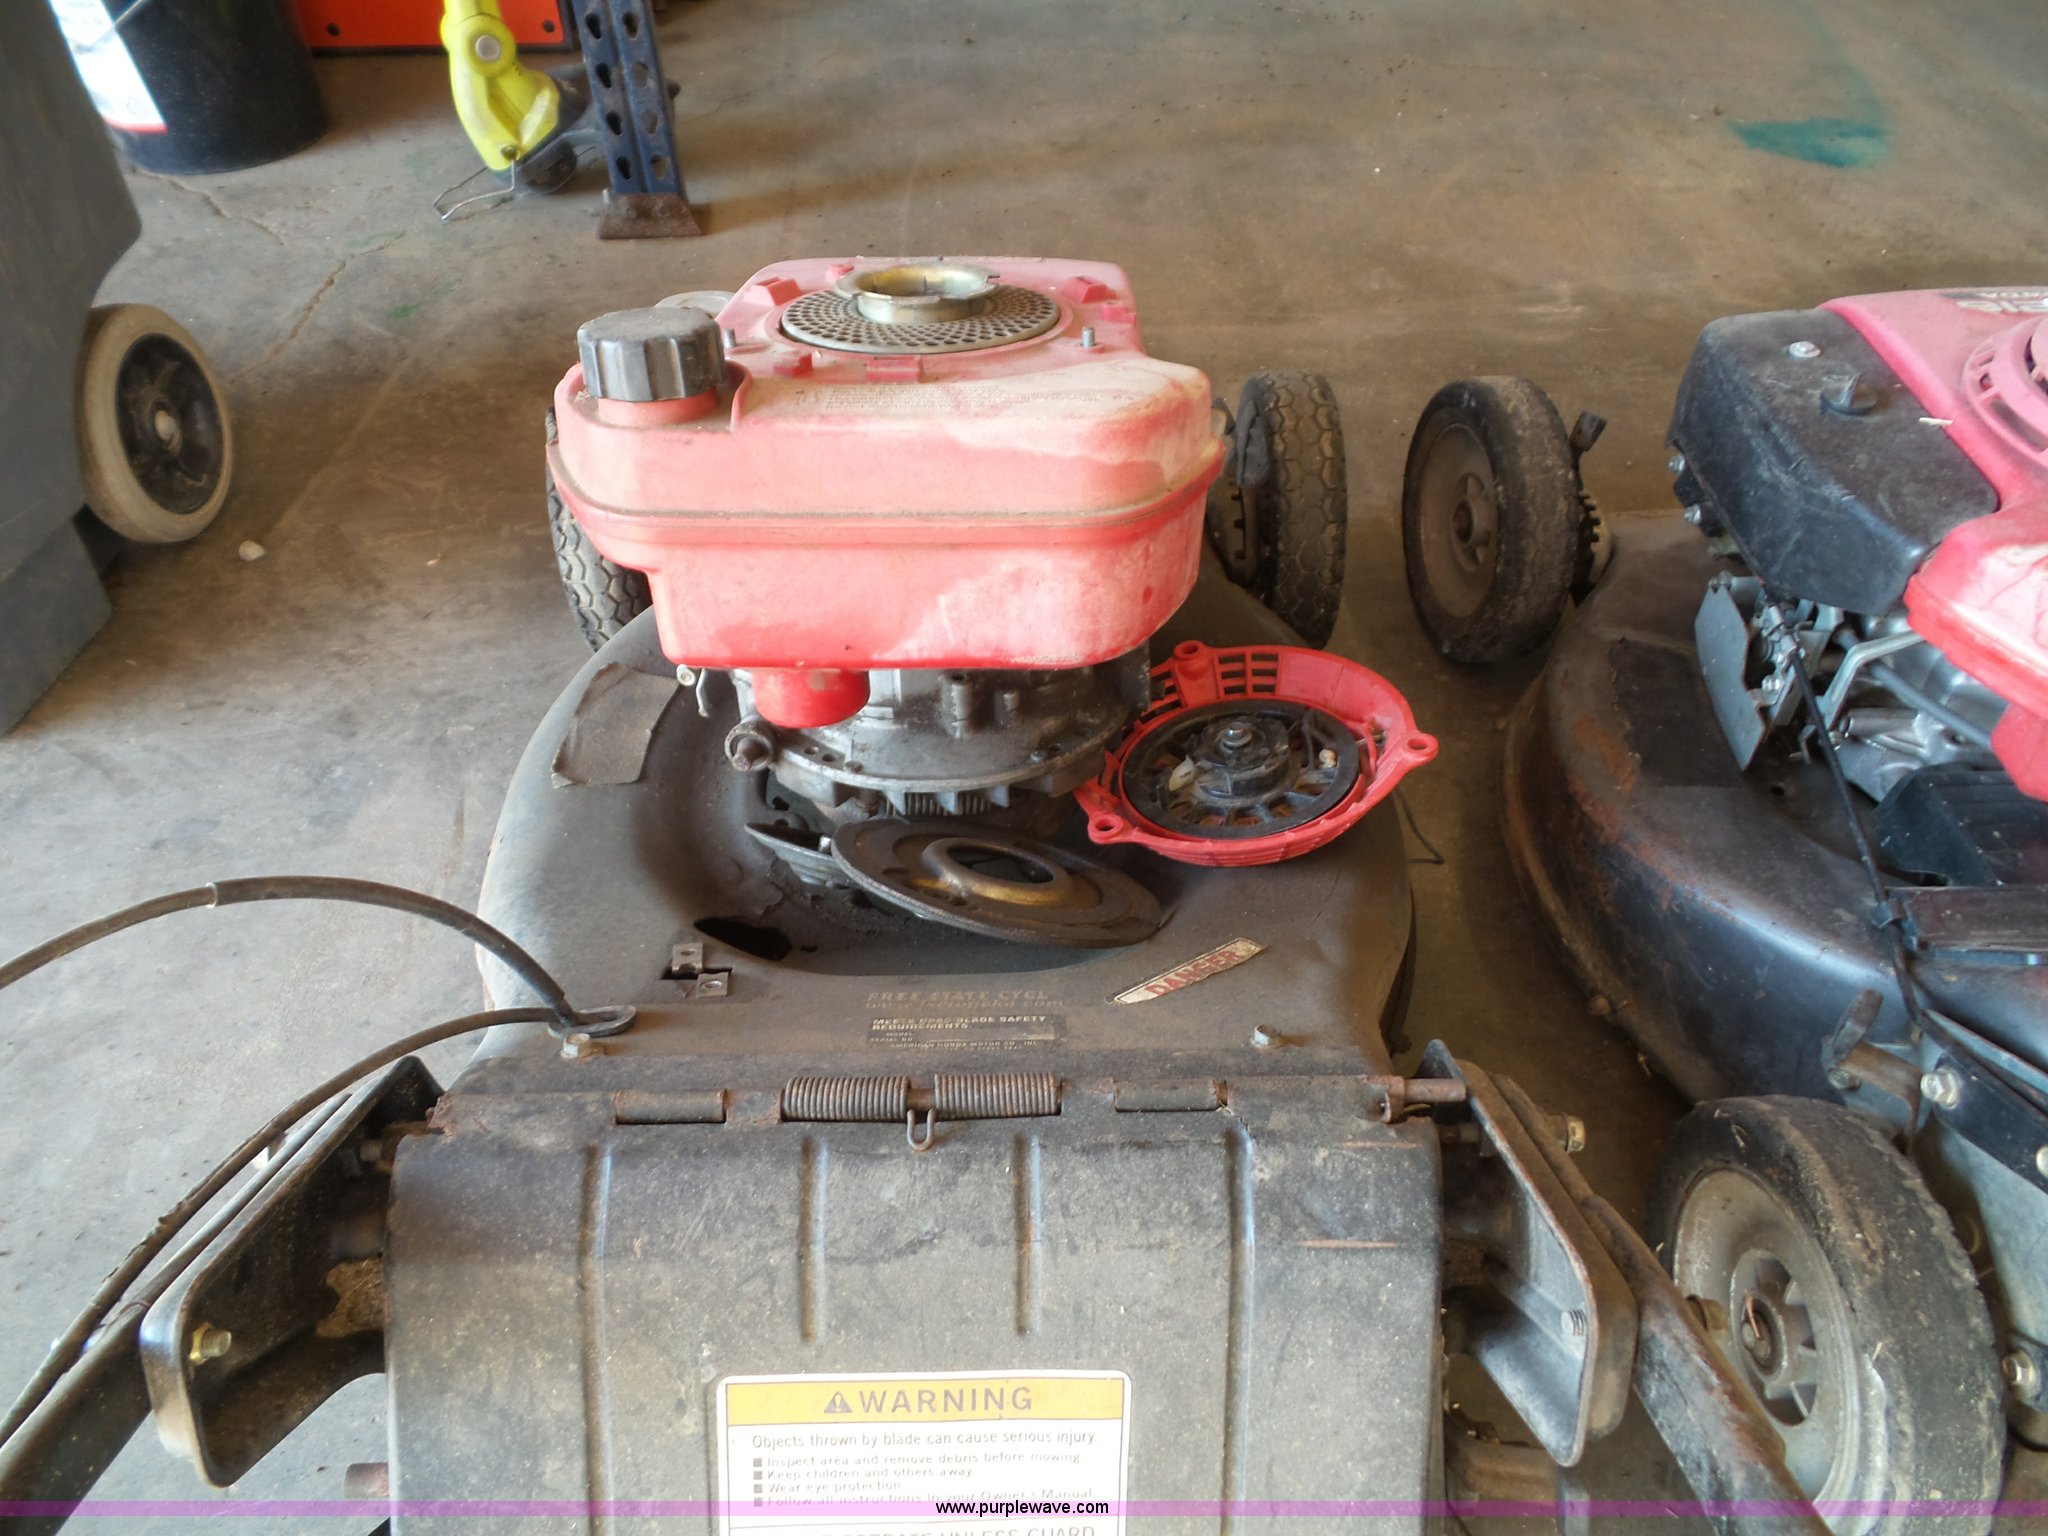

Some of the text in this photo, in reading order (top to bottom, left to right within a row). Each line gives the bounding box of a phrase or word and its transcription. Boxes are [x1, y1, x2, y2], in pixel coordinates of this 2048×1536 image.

[1144, 950, 1240, 997] DANGER
[858, 1386, 1033, 1415] WARNING
[752, 1434, 805, 1451] Objects
[810, 1434, 857, 1446] thrown
[862, 1433, 878, 1449] by
[883, 1432, 921, 1445] blade
[927, 1433, 951, 1444] can
[957, 1432, 997, 1443] cause
[1003, 1431, 1052, 1442] serious
[767, 1457, 815, 1468] Inspect
[855, 1455, 879, 1464] and
[884, 1456, 933, 1464] remove
[938, 1453, 979, 1463] debris
[984, 1451, 1025, 1462] before
[767, 1470, 801, 1481] Keep
[806, 1469, 860, 1479] children
[865, 1468, 888, 1477] and
[894, 1467, 935, 1477] others
[769, 1483, 801, 1493] Wear
[806, 1484, 829, 1494] eye
[818, 1495, 834, 1505] all
